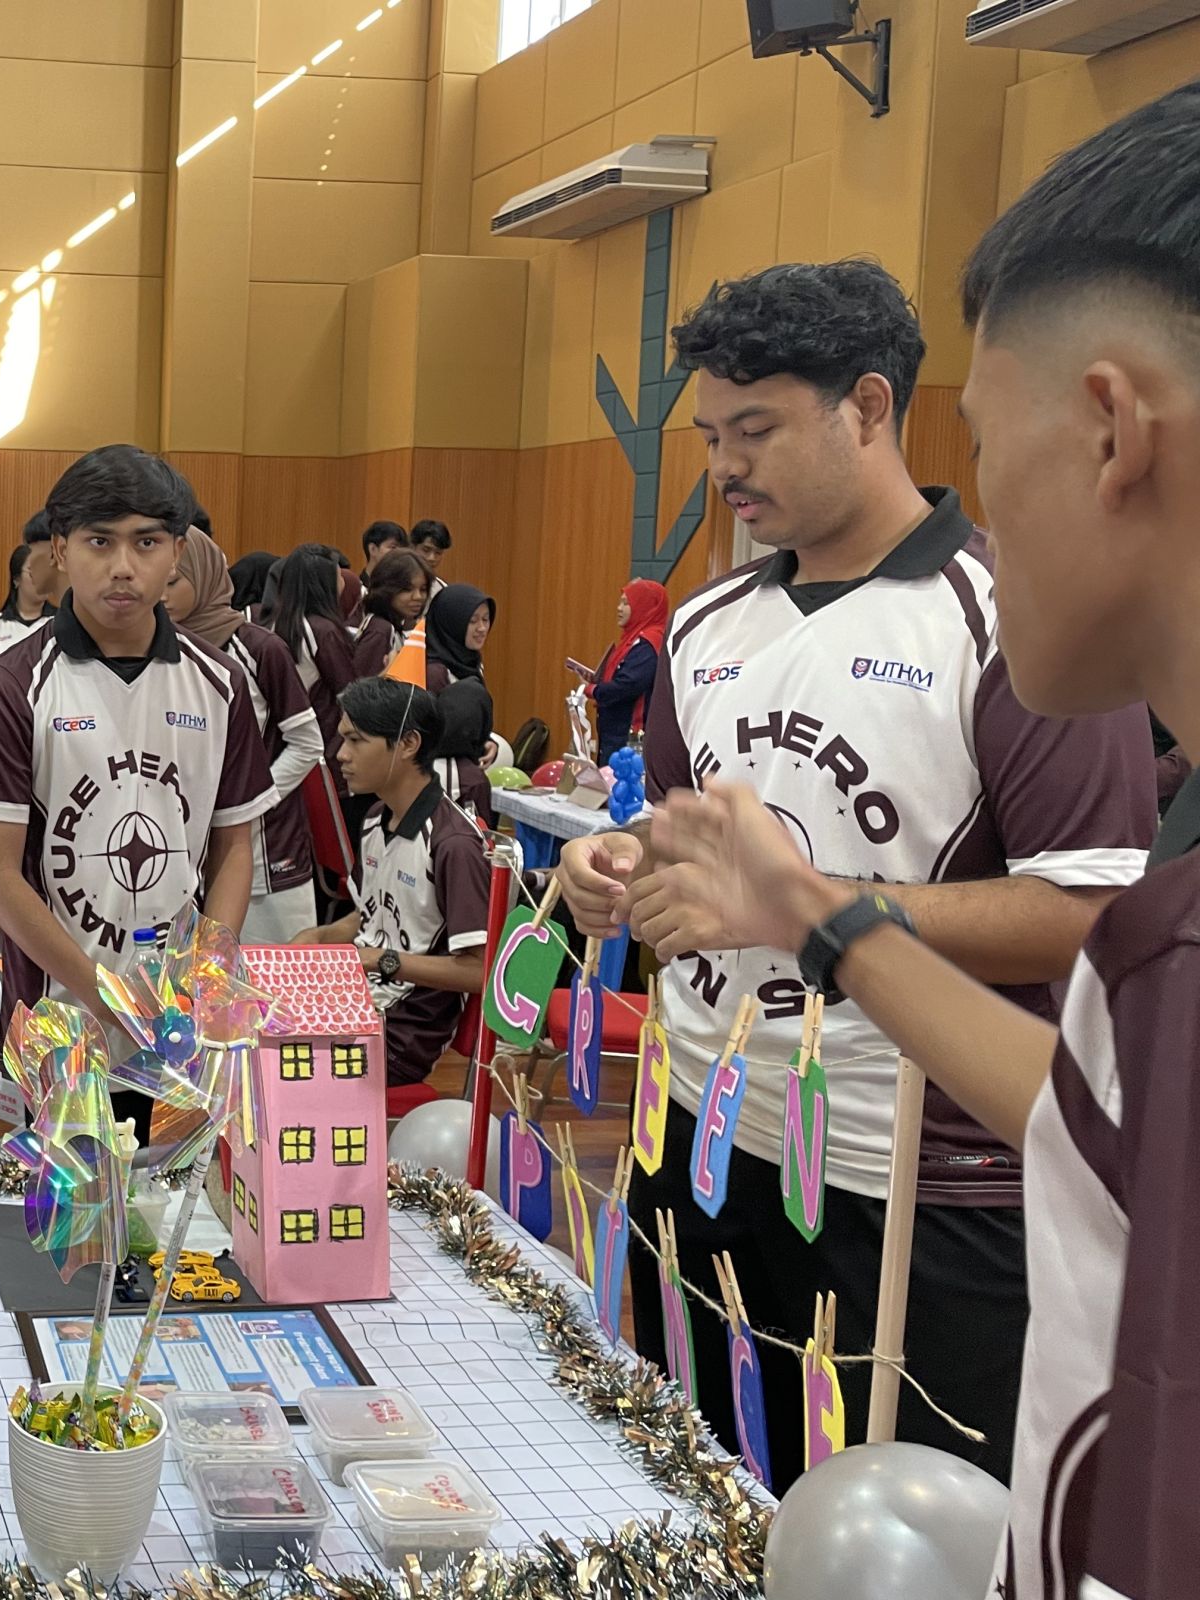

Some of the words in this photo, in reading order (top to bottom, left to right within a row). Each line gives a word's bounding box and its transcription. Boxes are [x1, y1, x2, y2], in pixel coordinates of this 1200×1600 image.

[872, 659, 933, 688] UTHM
[736, 710, 900, 845] HERO
[50, 773, 128, 954] NATURE
[203, 1288, 219, 1298] TAXI
[378, 1398, 404, 1422] FINE
